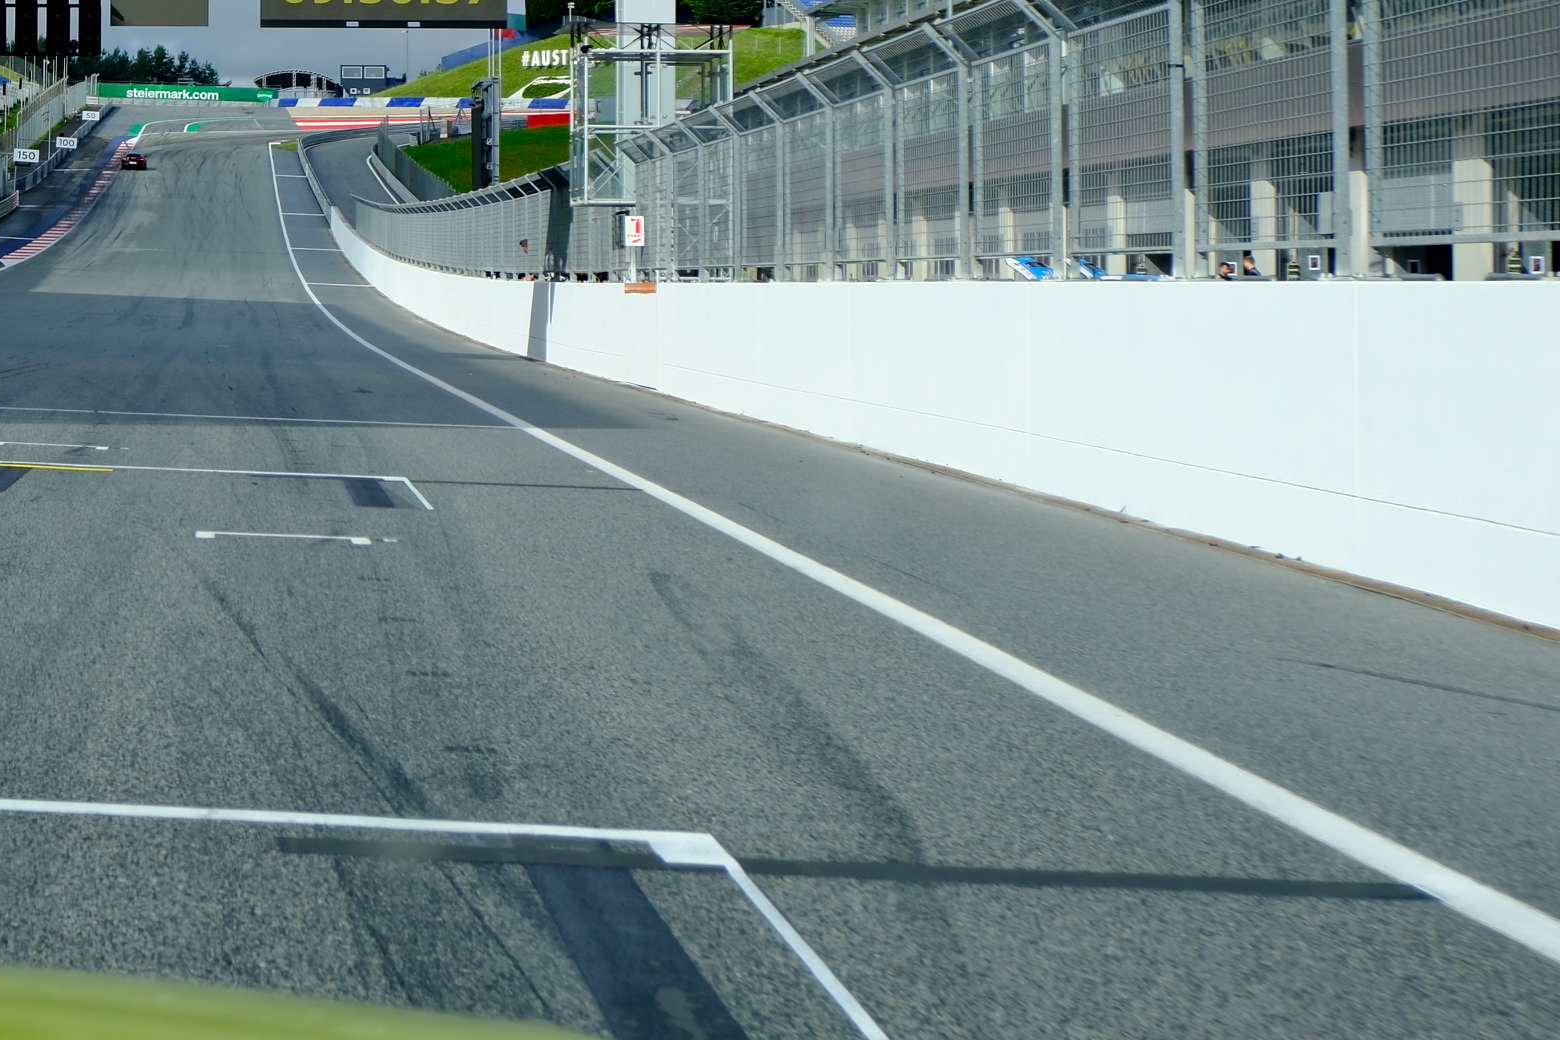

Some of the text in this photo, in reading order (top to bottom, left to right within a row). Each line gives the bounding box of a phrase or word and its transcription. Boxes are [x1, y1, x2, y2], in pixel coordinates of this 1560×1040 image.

[521, 49, 577, 67] #AUST
[126, 87, 219, 101] steiermark.com
[59, 138, 75, 147] 100
[17, 150, 36, 160] 150
